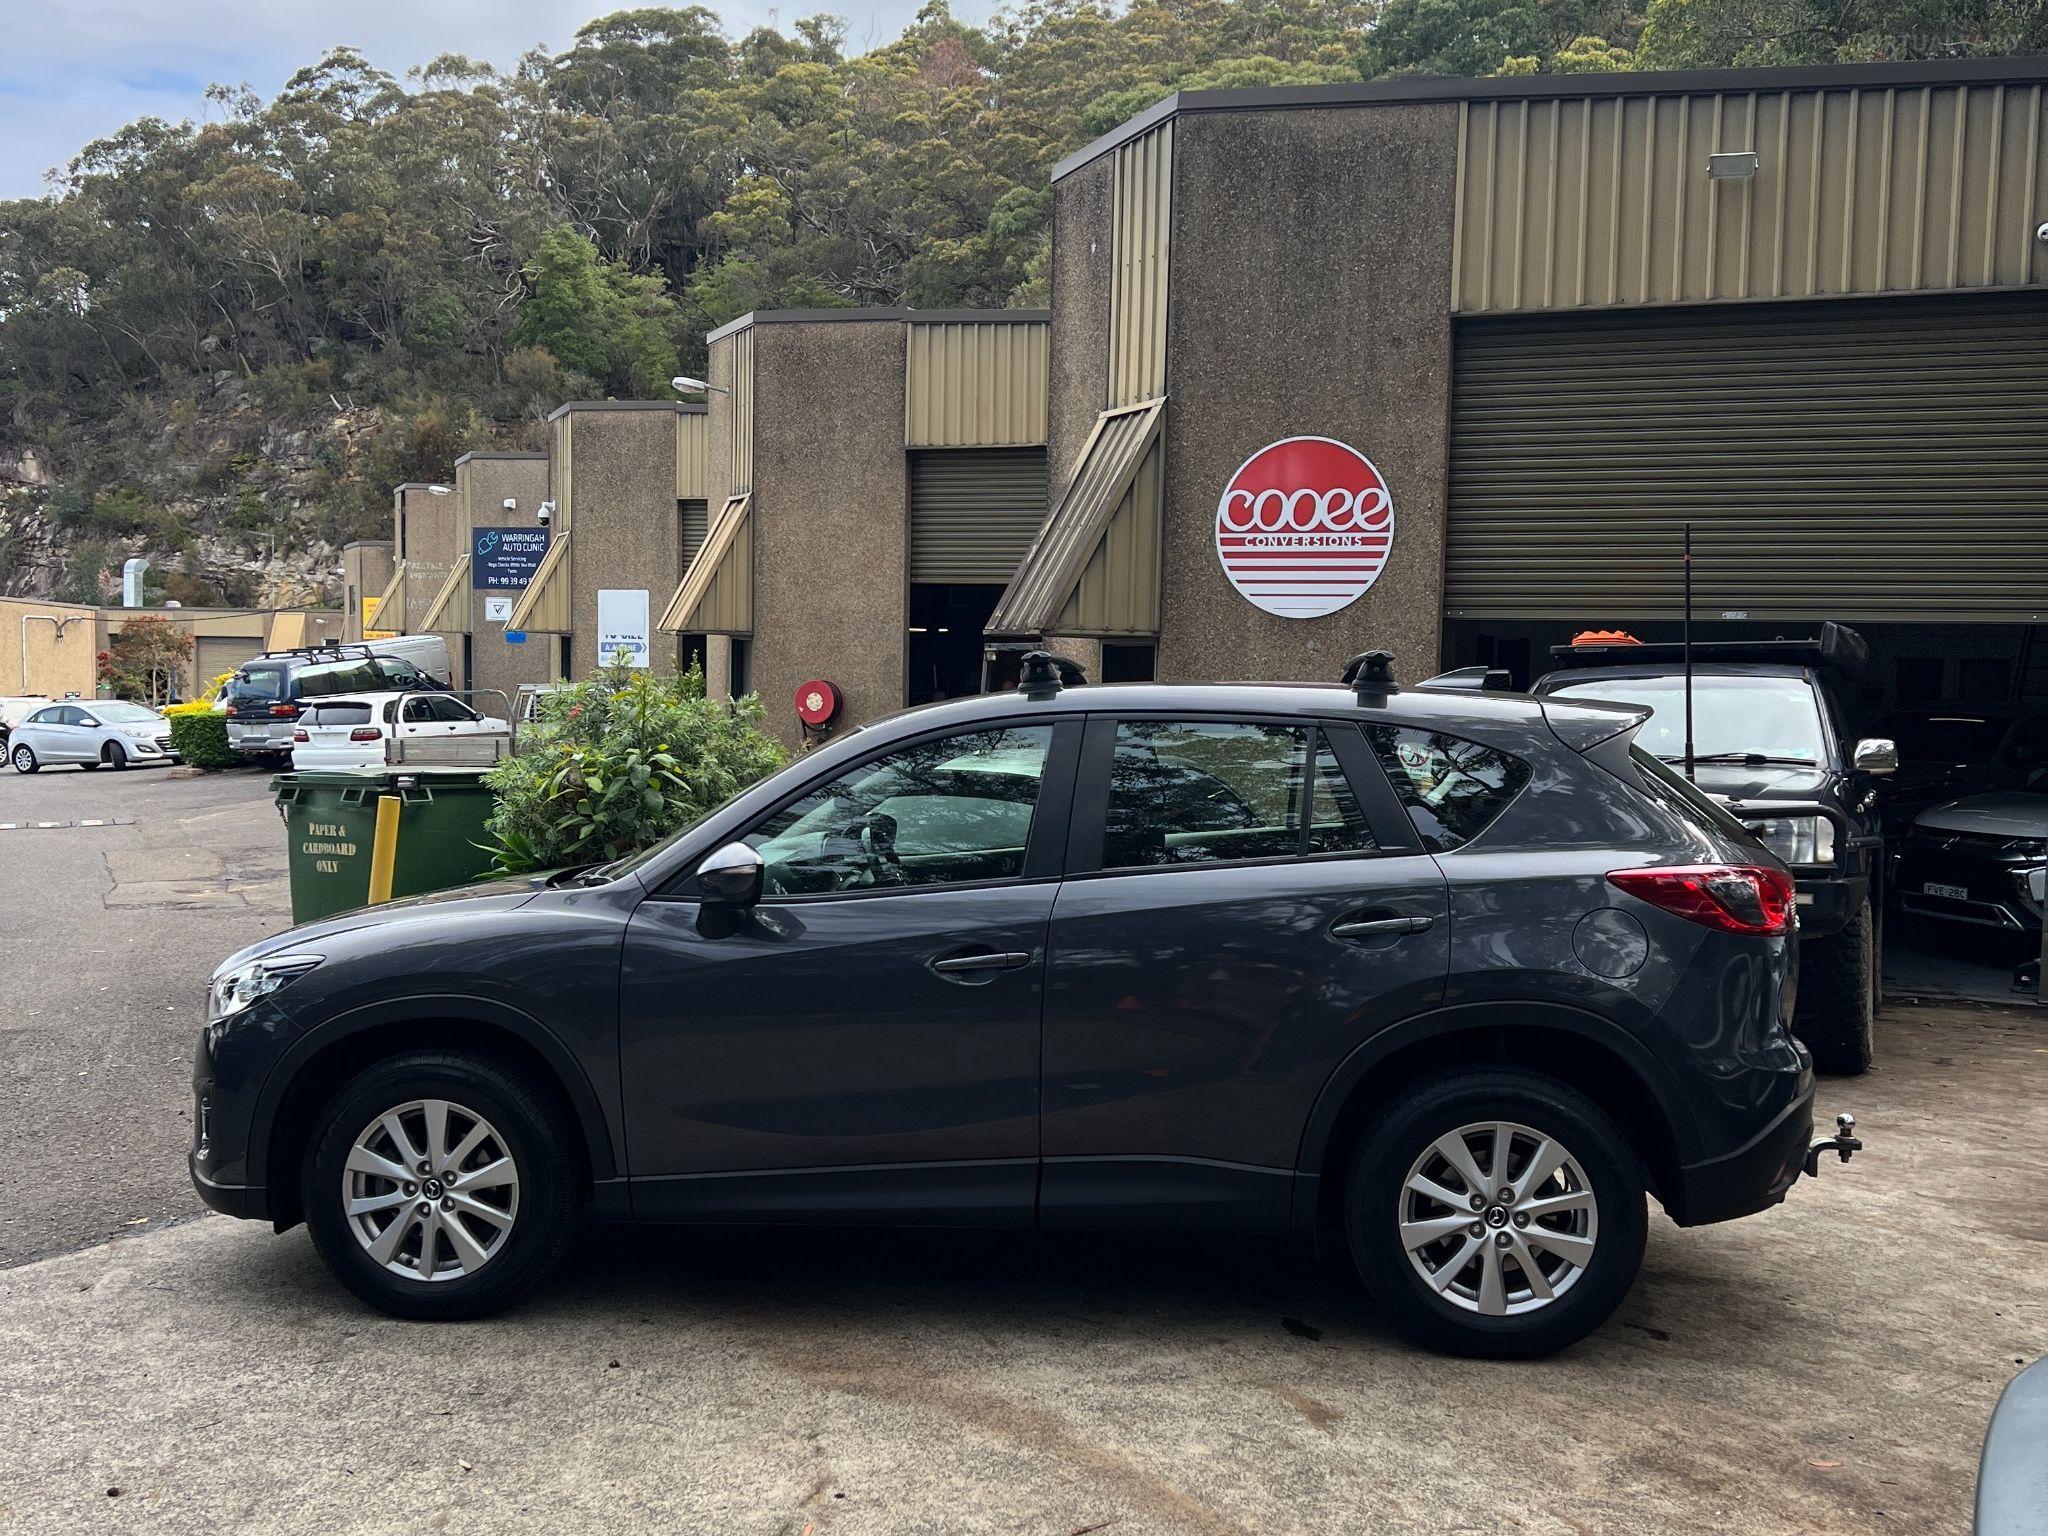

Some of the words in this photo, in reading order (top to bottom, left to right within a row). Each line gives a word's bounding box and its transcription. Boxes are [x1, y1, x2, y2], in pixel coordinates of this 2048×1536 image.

[1220, 487, 1391, 532] cooee
[501, 533, 545, 543] WARRINGAH
[1244, 536, 1363, 547] CONVERSIONS
[502, 543, 522, 552] AUTO
[523, 543, 545, 552] CLINIC
[500, 577, 509, 585] 99
[510, 577, 518, 585] 39
[519, 577, 528, 586] 49
[308, 822, 337, 837] PAPER
[338, 825, 346, 837] &
[302, 842, 357, 856] CARDBOARD
[316, 860, 339, 873] ONLY
